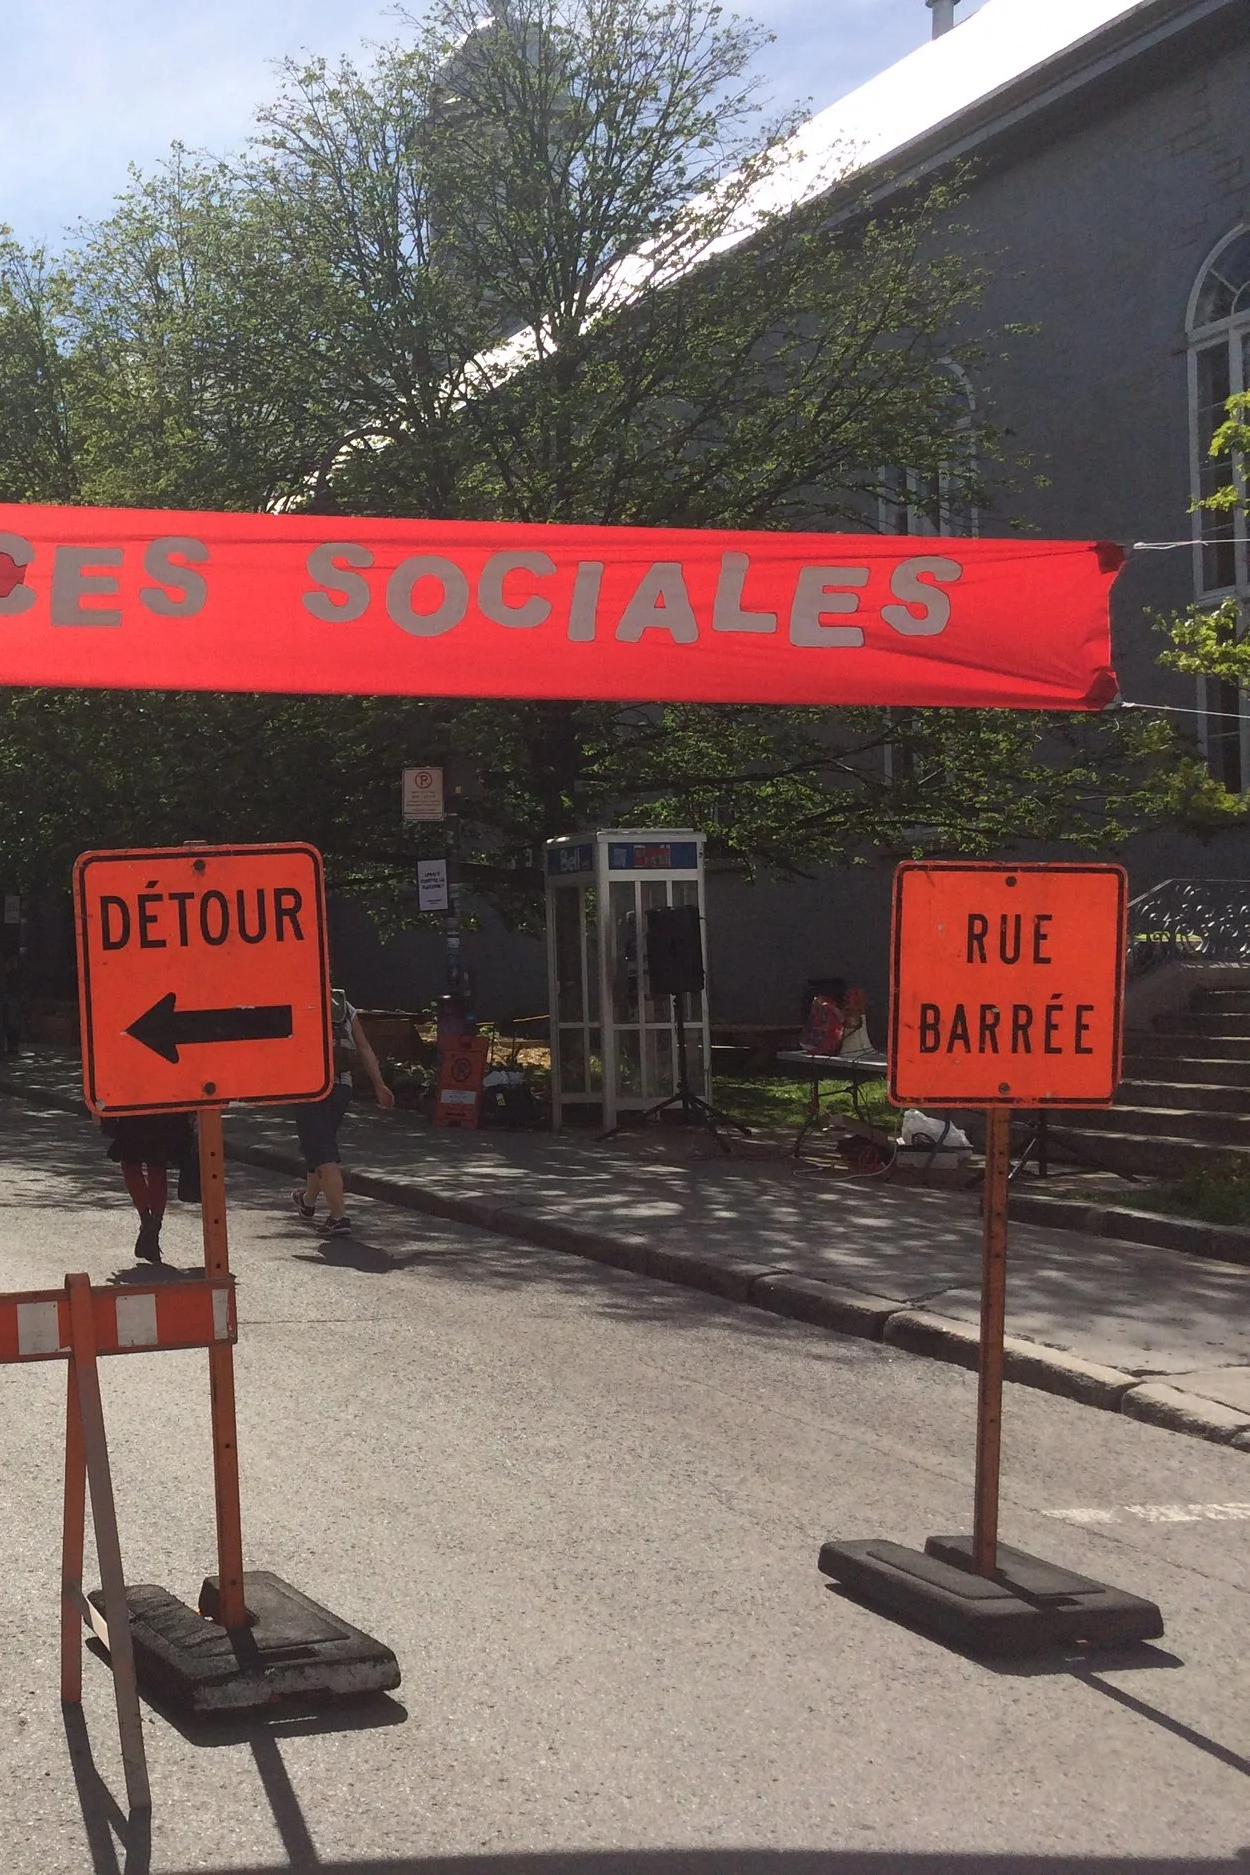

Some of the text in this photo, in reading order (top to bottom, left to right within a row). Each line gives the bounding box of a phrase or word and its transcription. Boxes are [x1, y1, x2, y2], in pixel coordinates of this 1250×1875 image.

[301, 541, 963, 648] SOCIALES
[560, 847, 581, 871] Bell
[99, 880, 305, 952] DÉTOUR
[966, 913, 1053, 965] RUE
[918, 993, 1095, 1056] BARRÉE
